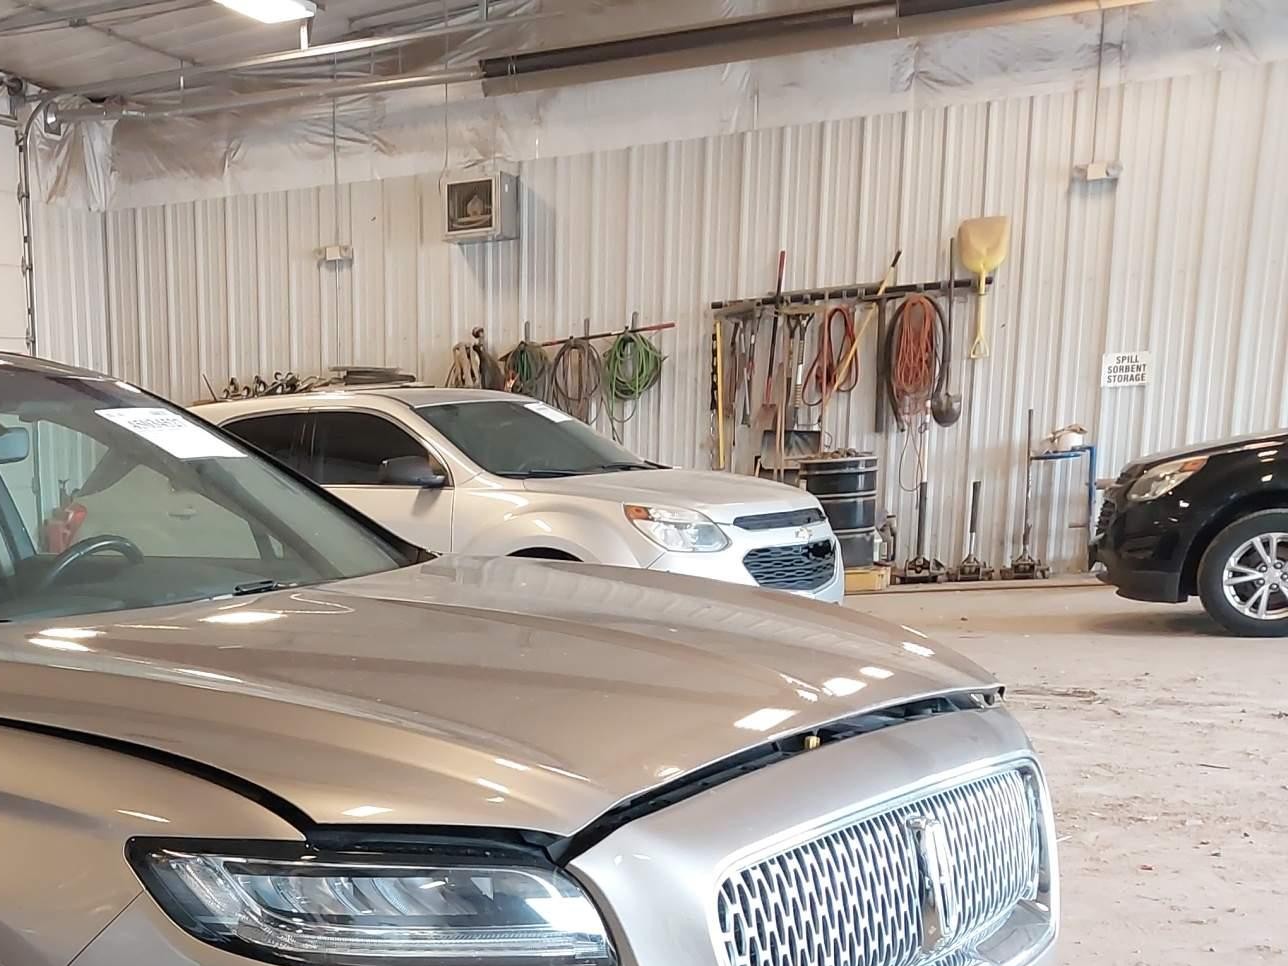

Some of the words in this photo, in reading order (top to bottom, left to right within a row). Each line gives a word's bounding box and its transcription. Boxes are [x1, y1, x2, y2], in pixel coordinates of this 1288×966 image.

[1116, 355, 1139, 364] SPILL
[1107, 364, 1147, 374] SORBENT
[1107, 373, 1146, 383] STORAGE
